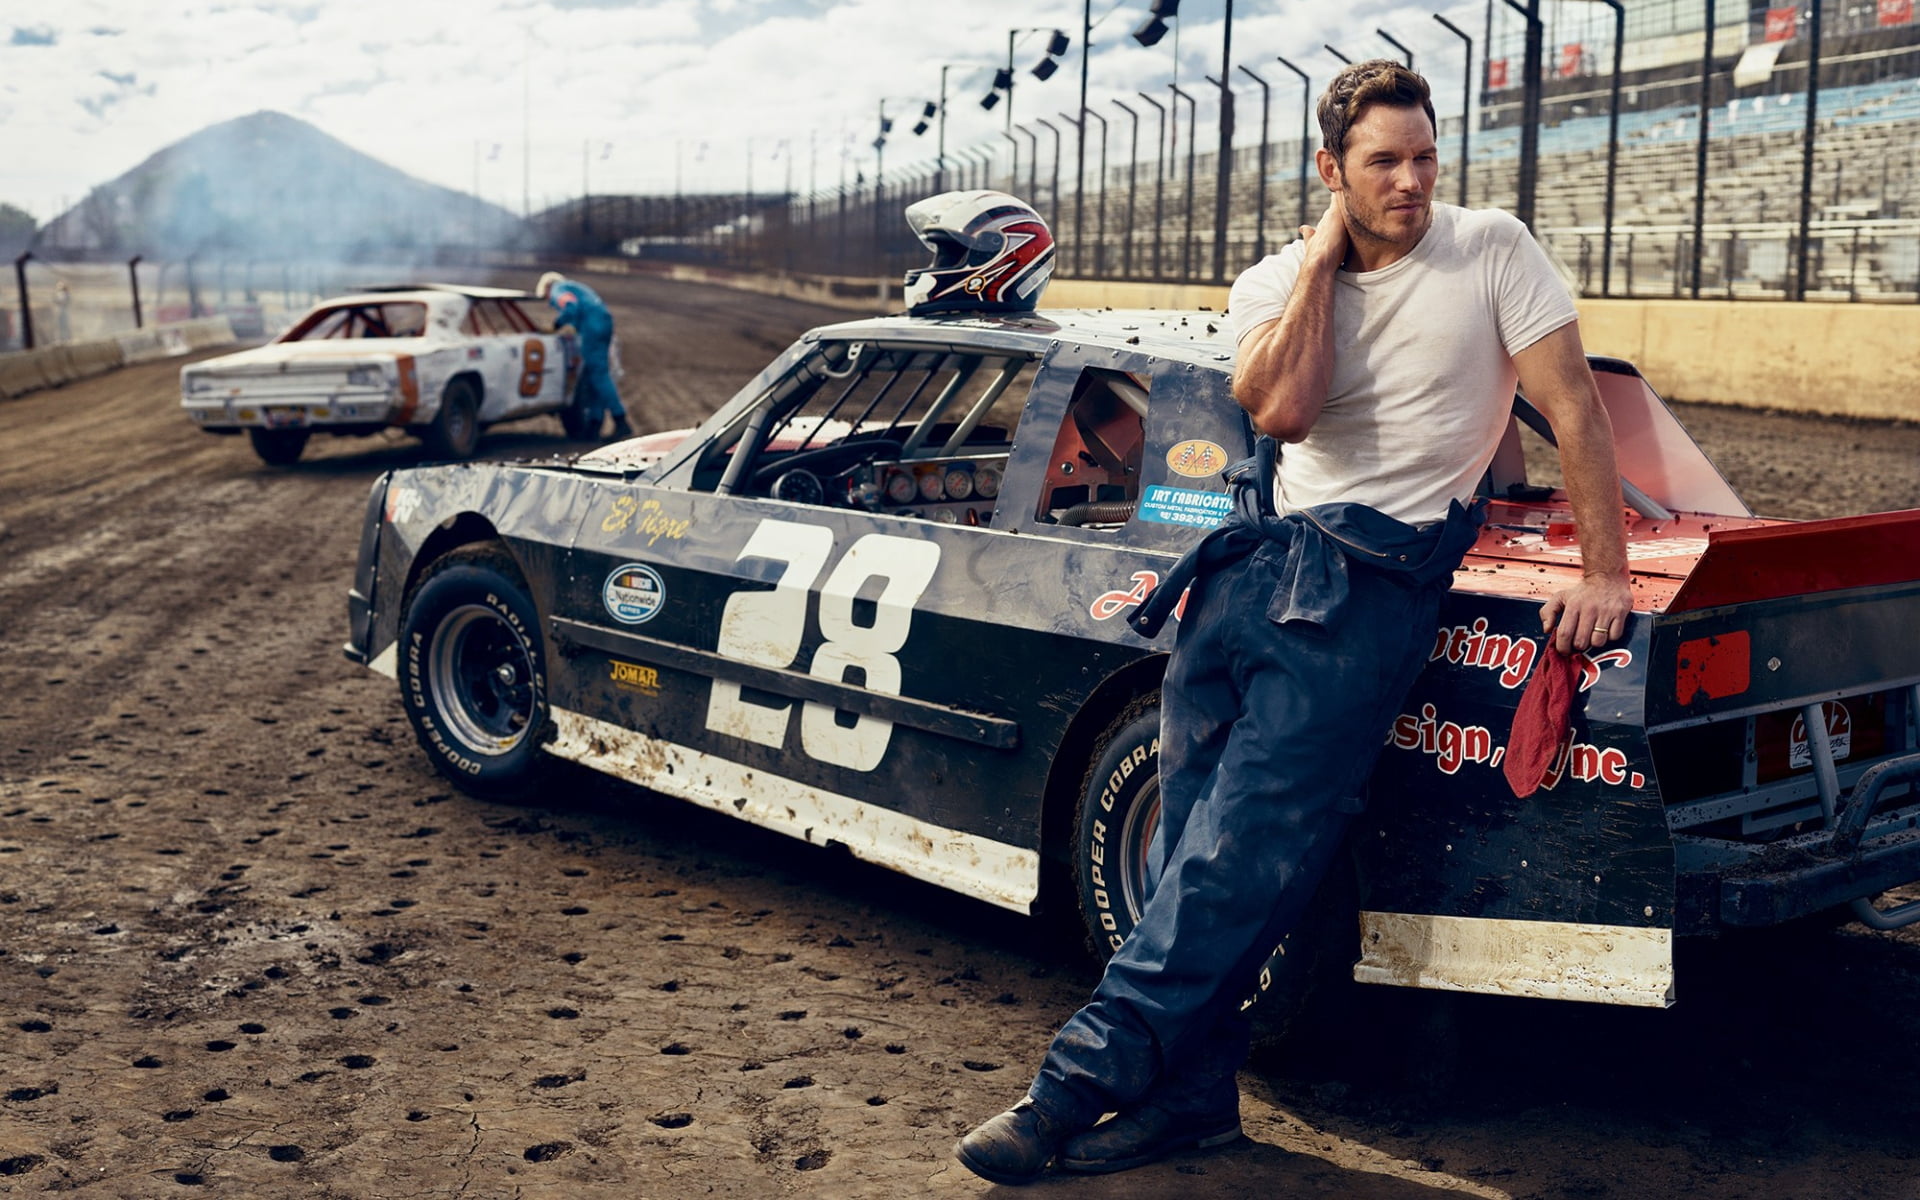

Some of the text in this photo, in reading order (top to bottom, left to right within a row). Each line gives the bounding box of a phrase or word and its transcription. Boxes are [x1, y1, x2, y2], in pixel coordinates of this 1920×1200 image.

[519, 339, 545, 398] 8
[1167, 504, 1183, 512] METAL
[486, 593, 537, 665] RADIAL
[705, 518, 941, 772] 28
[408, 631, 483, 776] COOPER COBRA
[608, 659, 661, 689] JOMAR
[1384, 702, 1506, 775] sign,
[1091, 737, 1161, 952] COOPER COBRA
